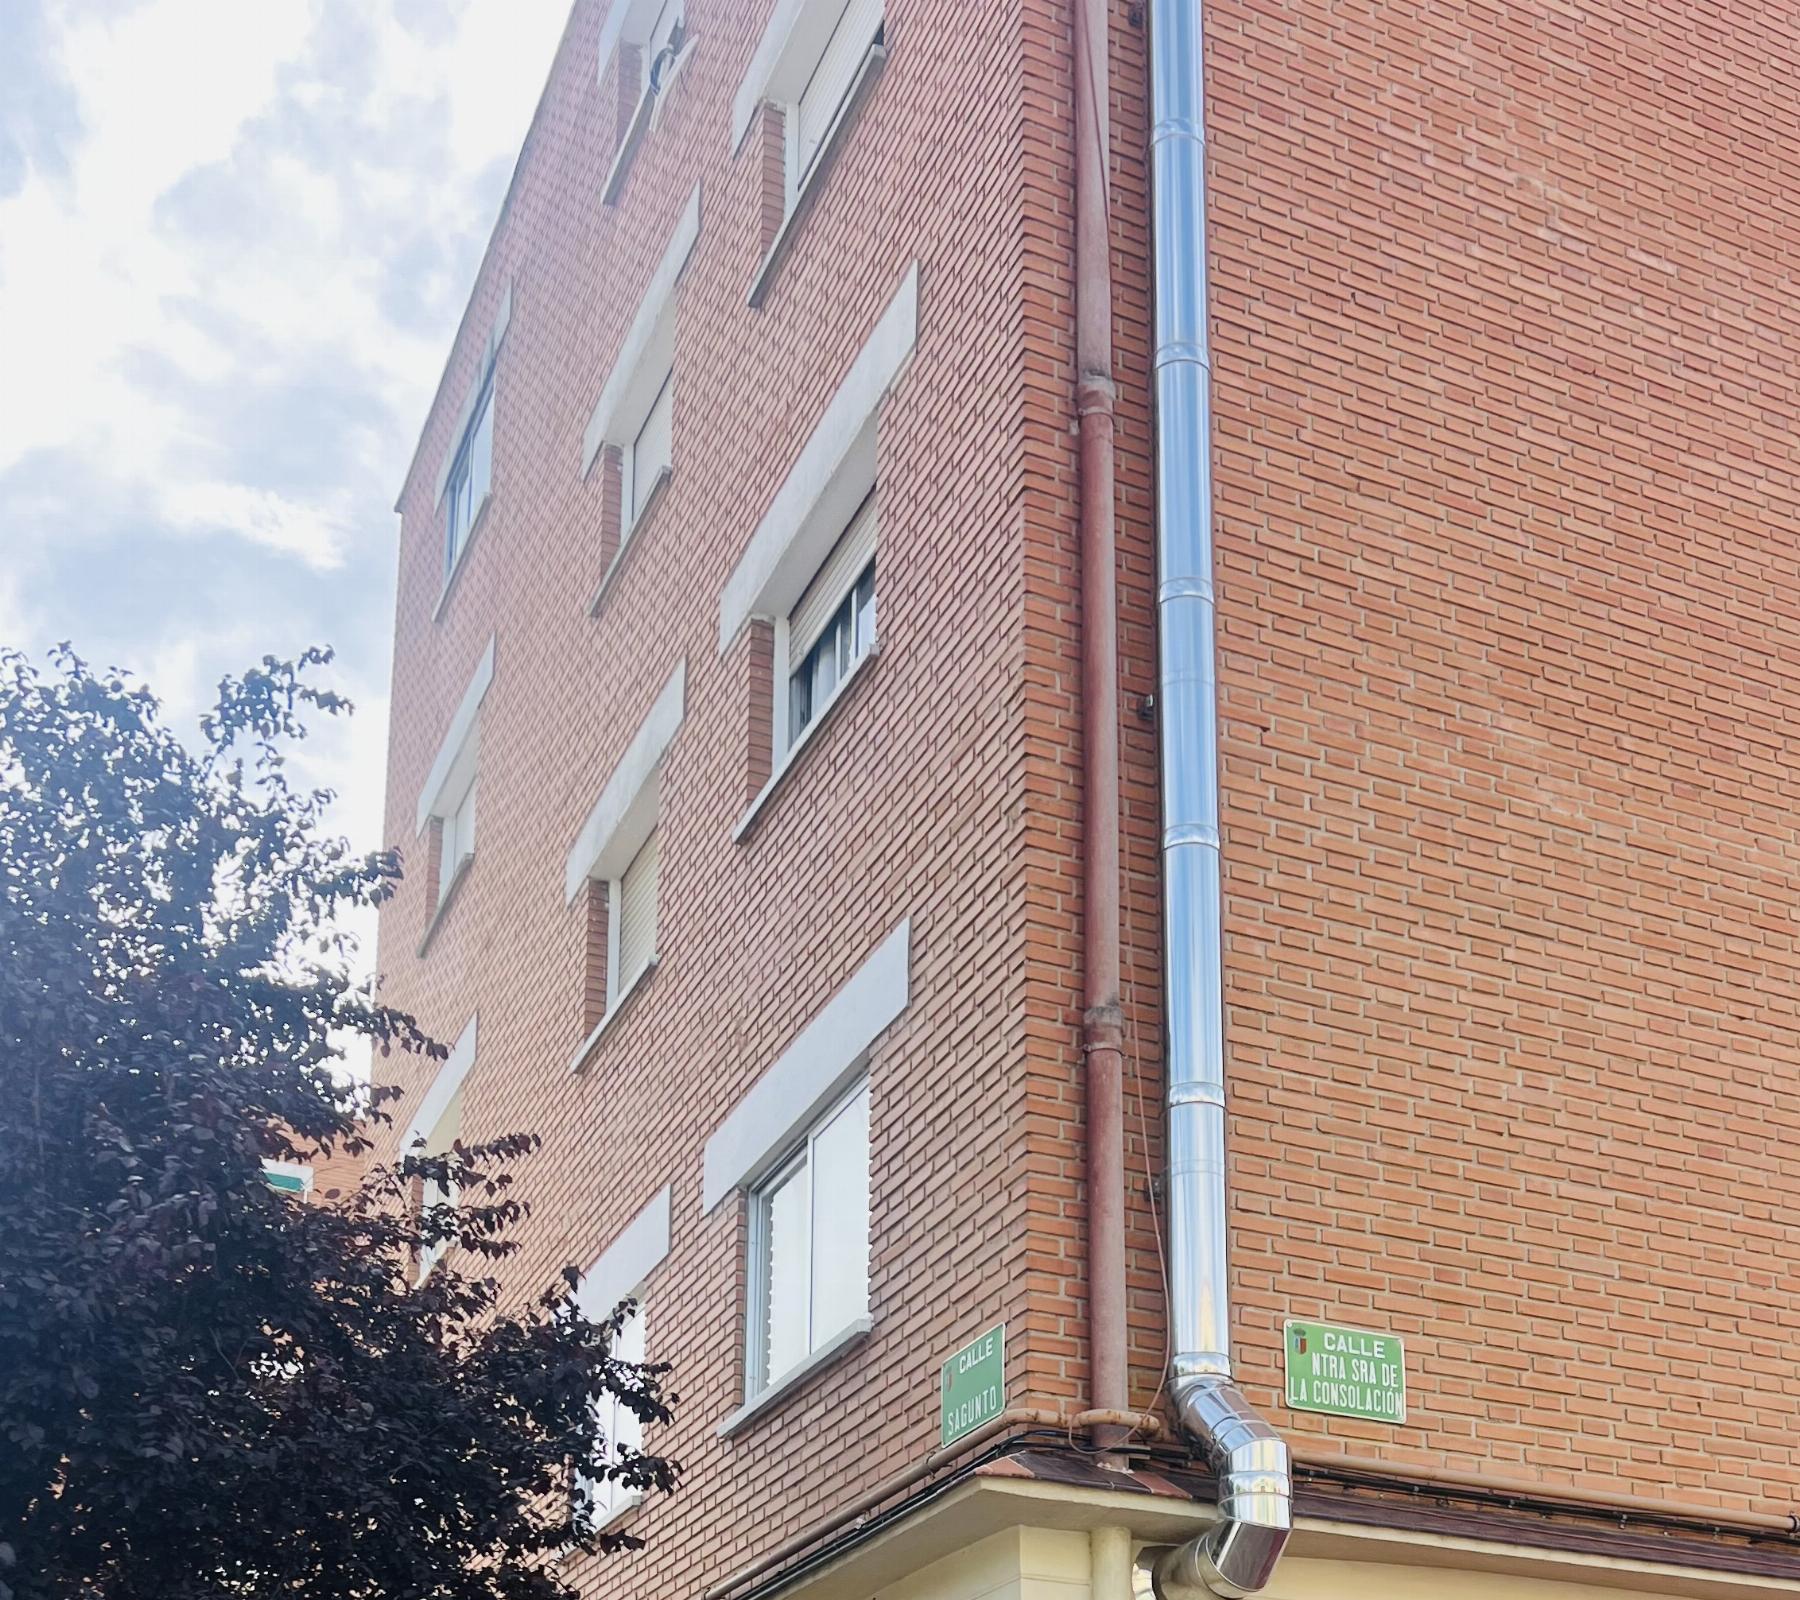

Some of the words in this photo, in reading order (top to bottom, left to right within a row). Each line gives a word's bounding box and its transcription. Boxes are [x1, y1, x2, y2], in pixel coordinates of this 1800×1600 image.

[959, 1337, 994, 1374] CALLE
[1324, 1332, 1386, 1359] CALLE
[1311, 1351, 1346, 1380] NTRA
[1351, 1358, 1377, 1385] SRA
[1381, 1363, 1399, 1388] DE
[948, 1385, 997, 1436] SAGUNTO
[1290, 1376, 1308, 1402] LA
[1313, 1380, 1403, 1416] CONSOLACIÓN
